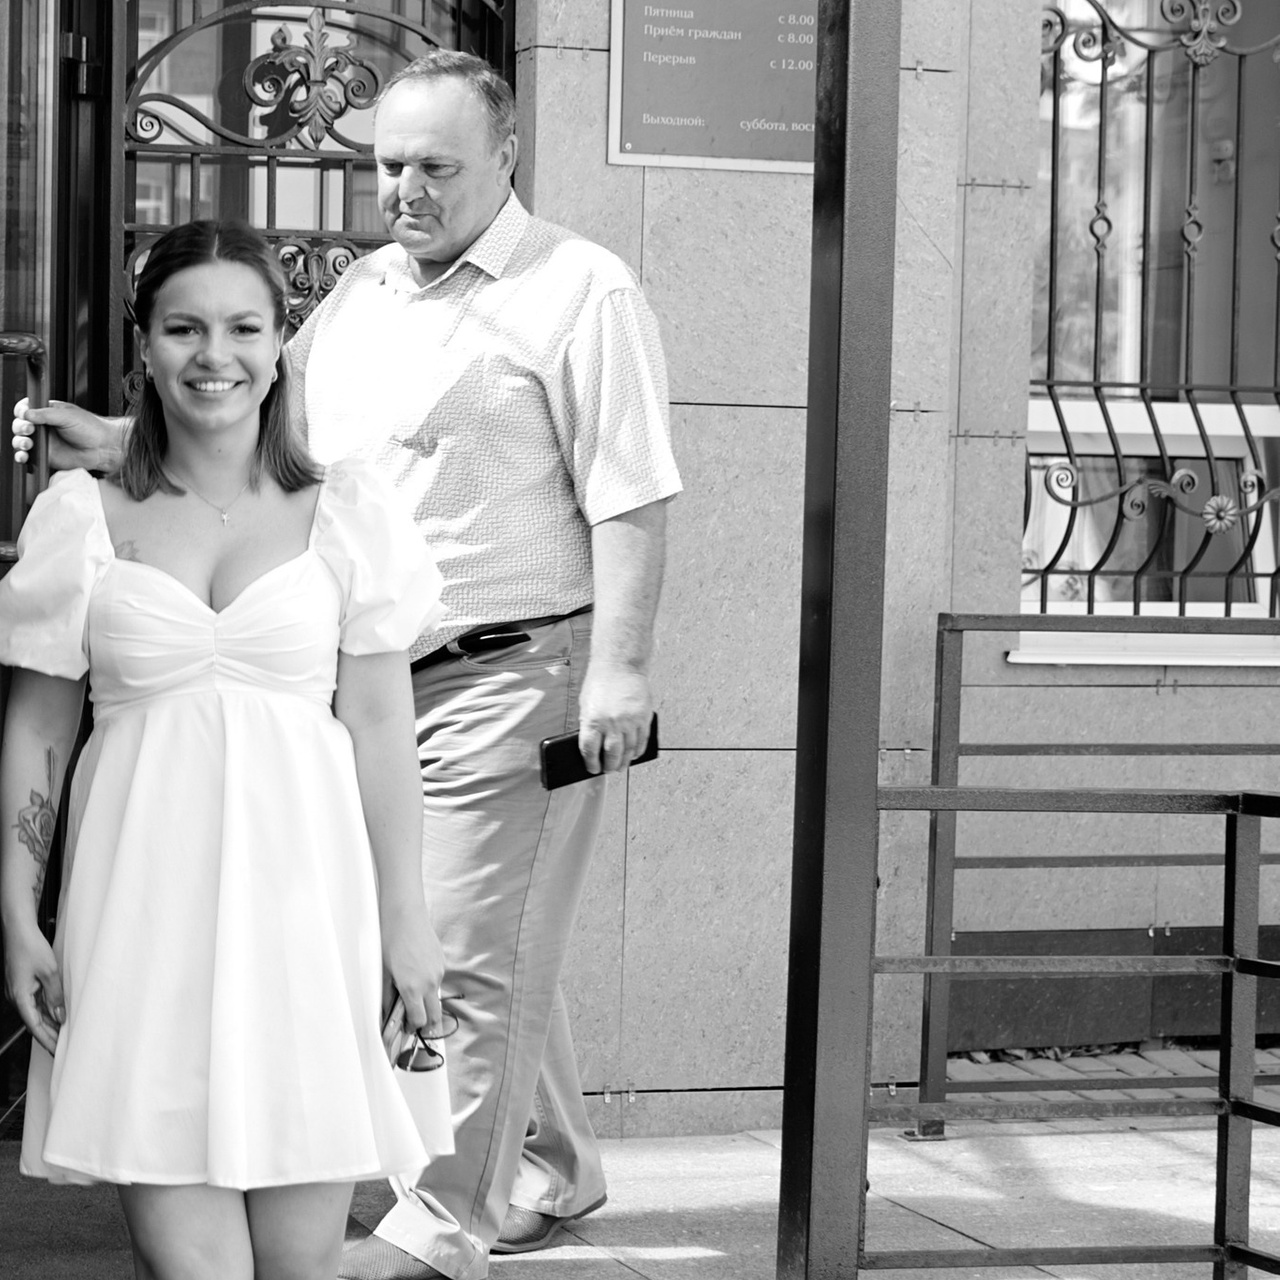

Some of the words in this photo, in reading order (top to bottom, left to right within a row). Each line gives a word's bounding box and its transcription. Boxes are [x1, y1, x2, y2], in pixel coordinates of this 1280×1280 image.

[644, 5, 695, 20] Пятница
[788, 14, 815, 26] 8.00
[644, 24, 685, 38] Приём
[688, 28, 742, 41] граждан
[787, 32, 814, 45] 8.00
[643, 51, 697, 67] Перерыв
[781, 58, 814, 71] 12.00
[642, 112, 706, 127] Выходной:
[740, 118, 789, 133] суббота,
